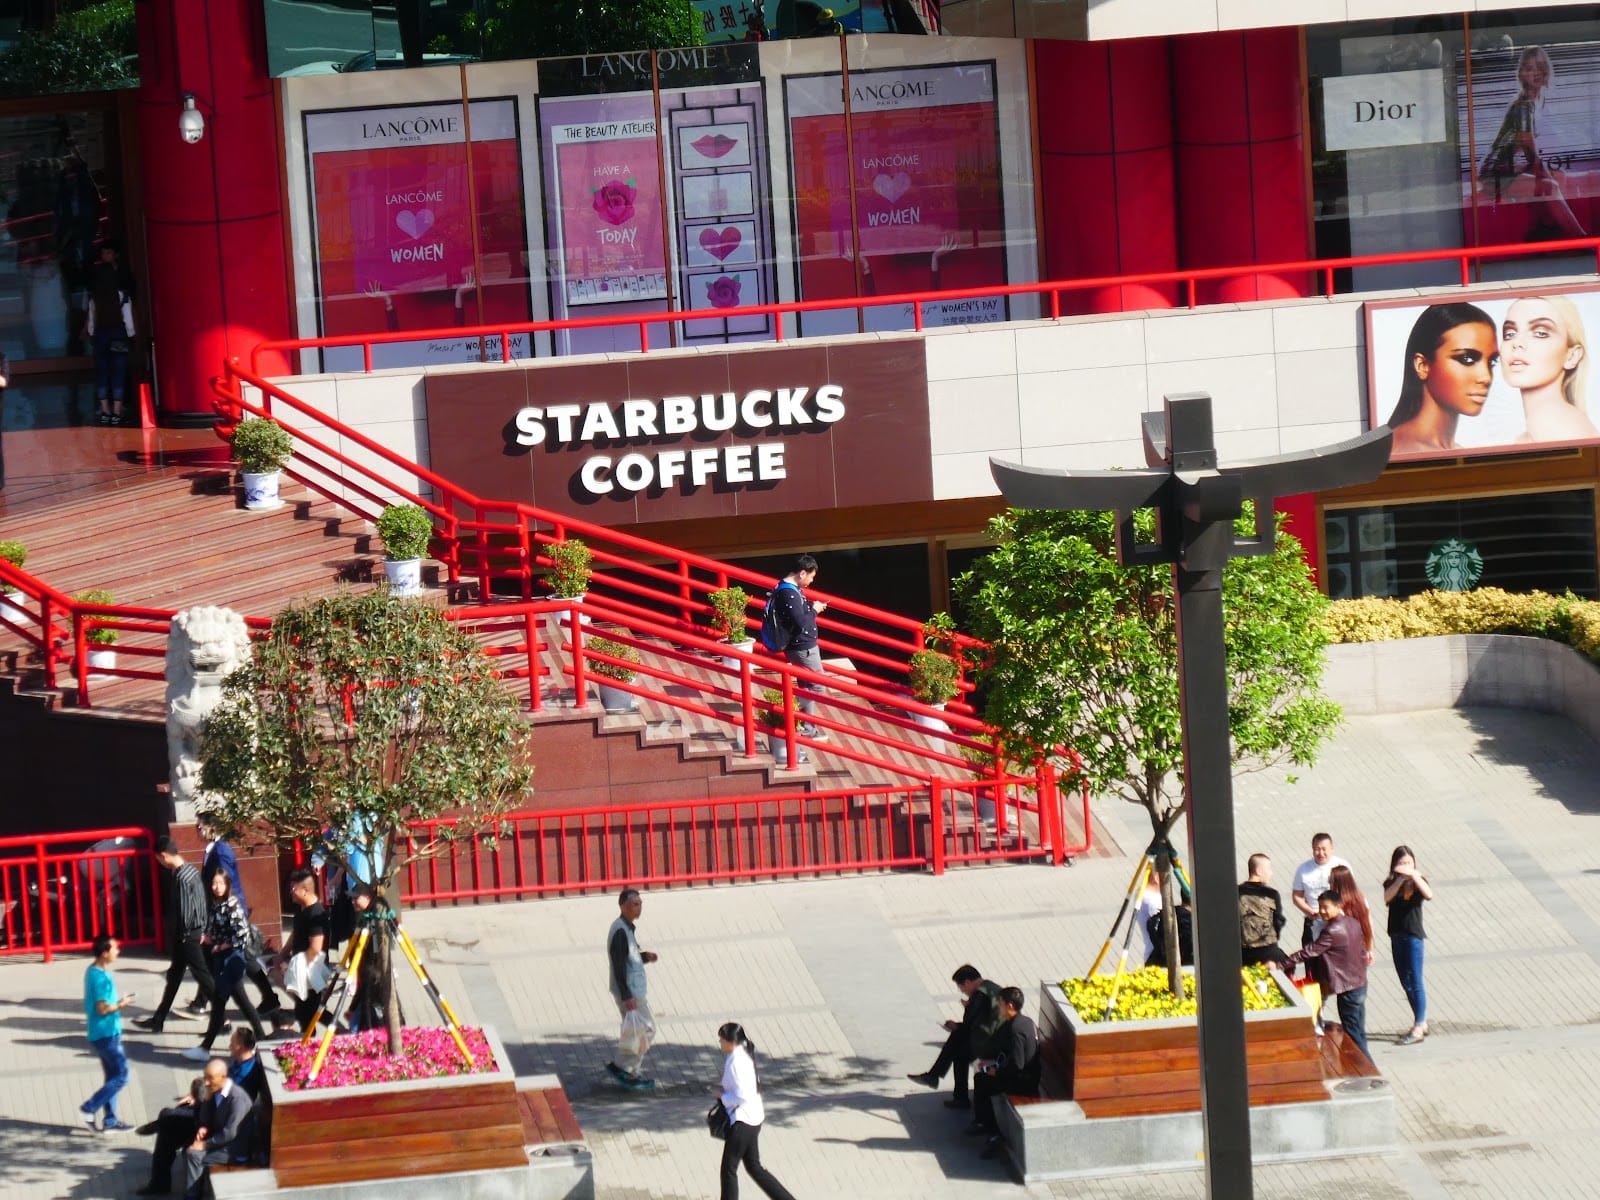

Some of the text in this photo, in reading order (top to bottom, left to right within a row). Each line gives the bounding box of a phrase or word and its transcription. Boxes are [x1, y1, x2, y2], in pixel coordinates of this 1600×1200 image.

[842, 81, 935, 103] ANCÔME
[1352, 100, 1416, 123] Dior
[362, 116, 459, 139] LANCÔME
[564, 122, 657, 139] THE BEAUTY ATELIER
[593, 165, 631, 177] HAVE A
[863, 154, 920, 169] LANCÔME
[385, 190, 443, 205] LANCÔME
[868, 206, 920, 227] WOMEN
[596, 227, 637, 246] TODAY
[390, 243, 444, 264] WOMEN
[941, 300, 980, 313] WOMEN'S
[982, 299, 998, 311] DAY
[515, 384, 846, 447] STARBUCKS
[580, 442, 787, 495] COFFEE
